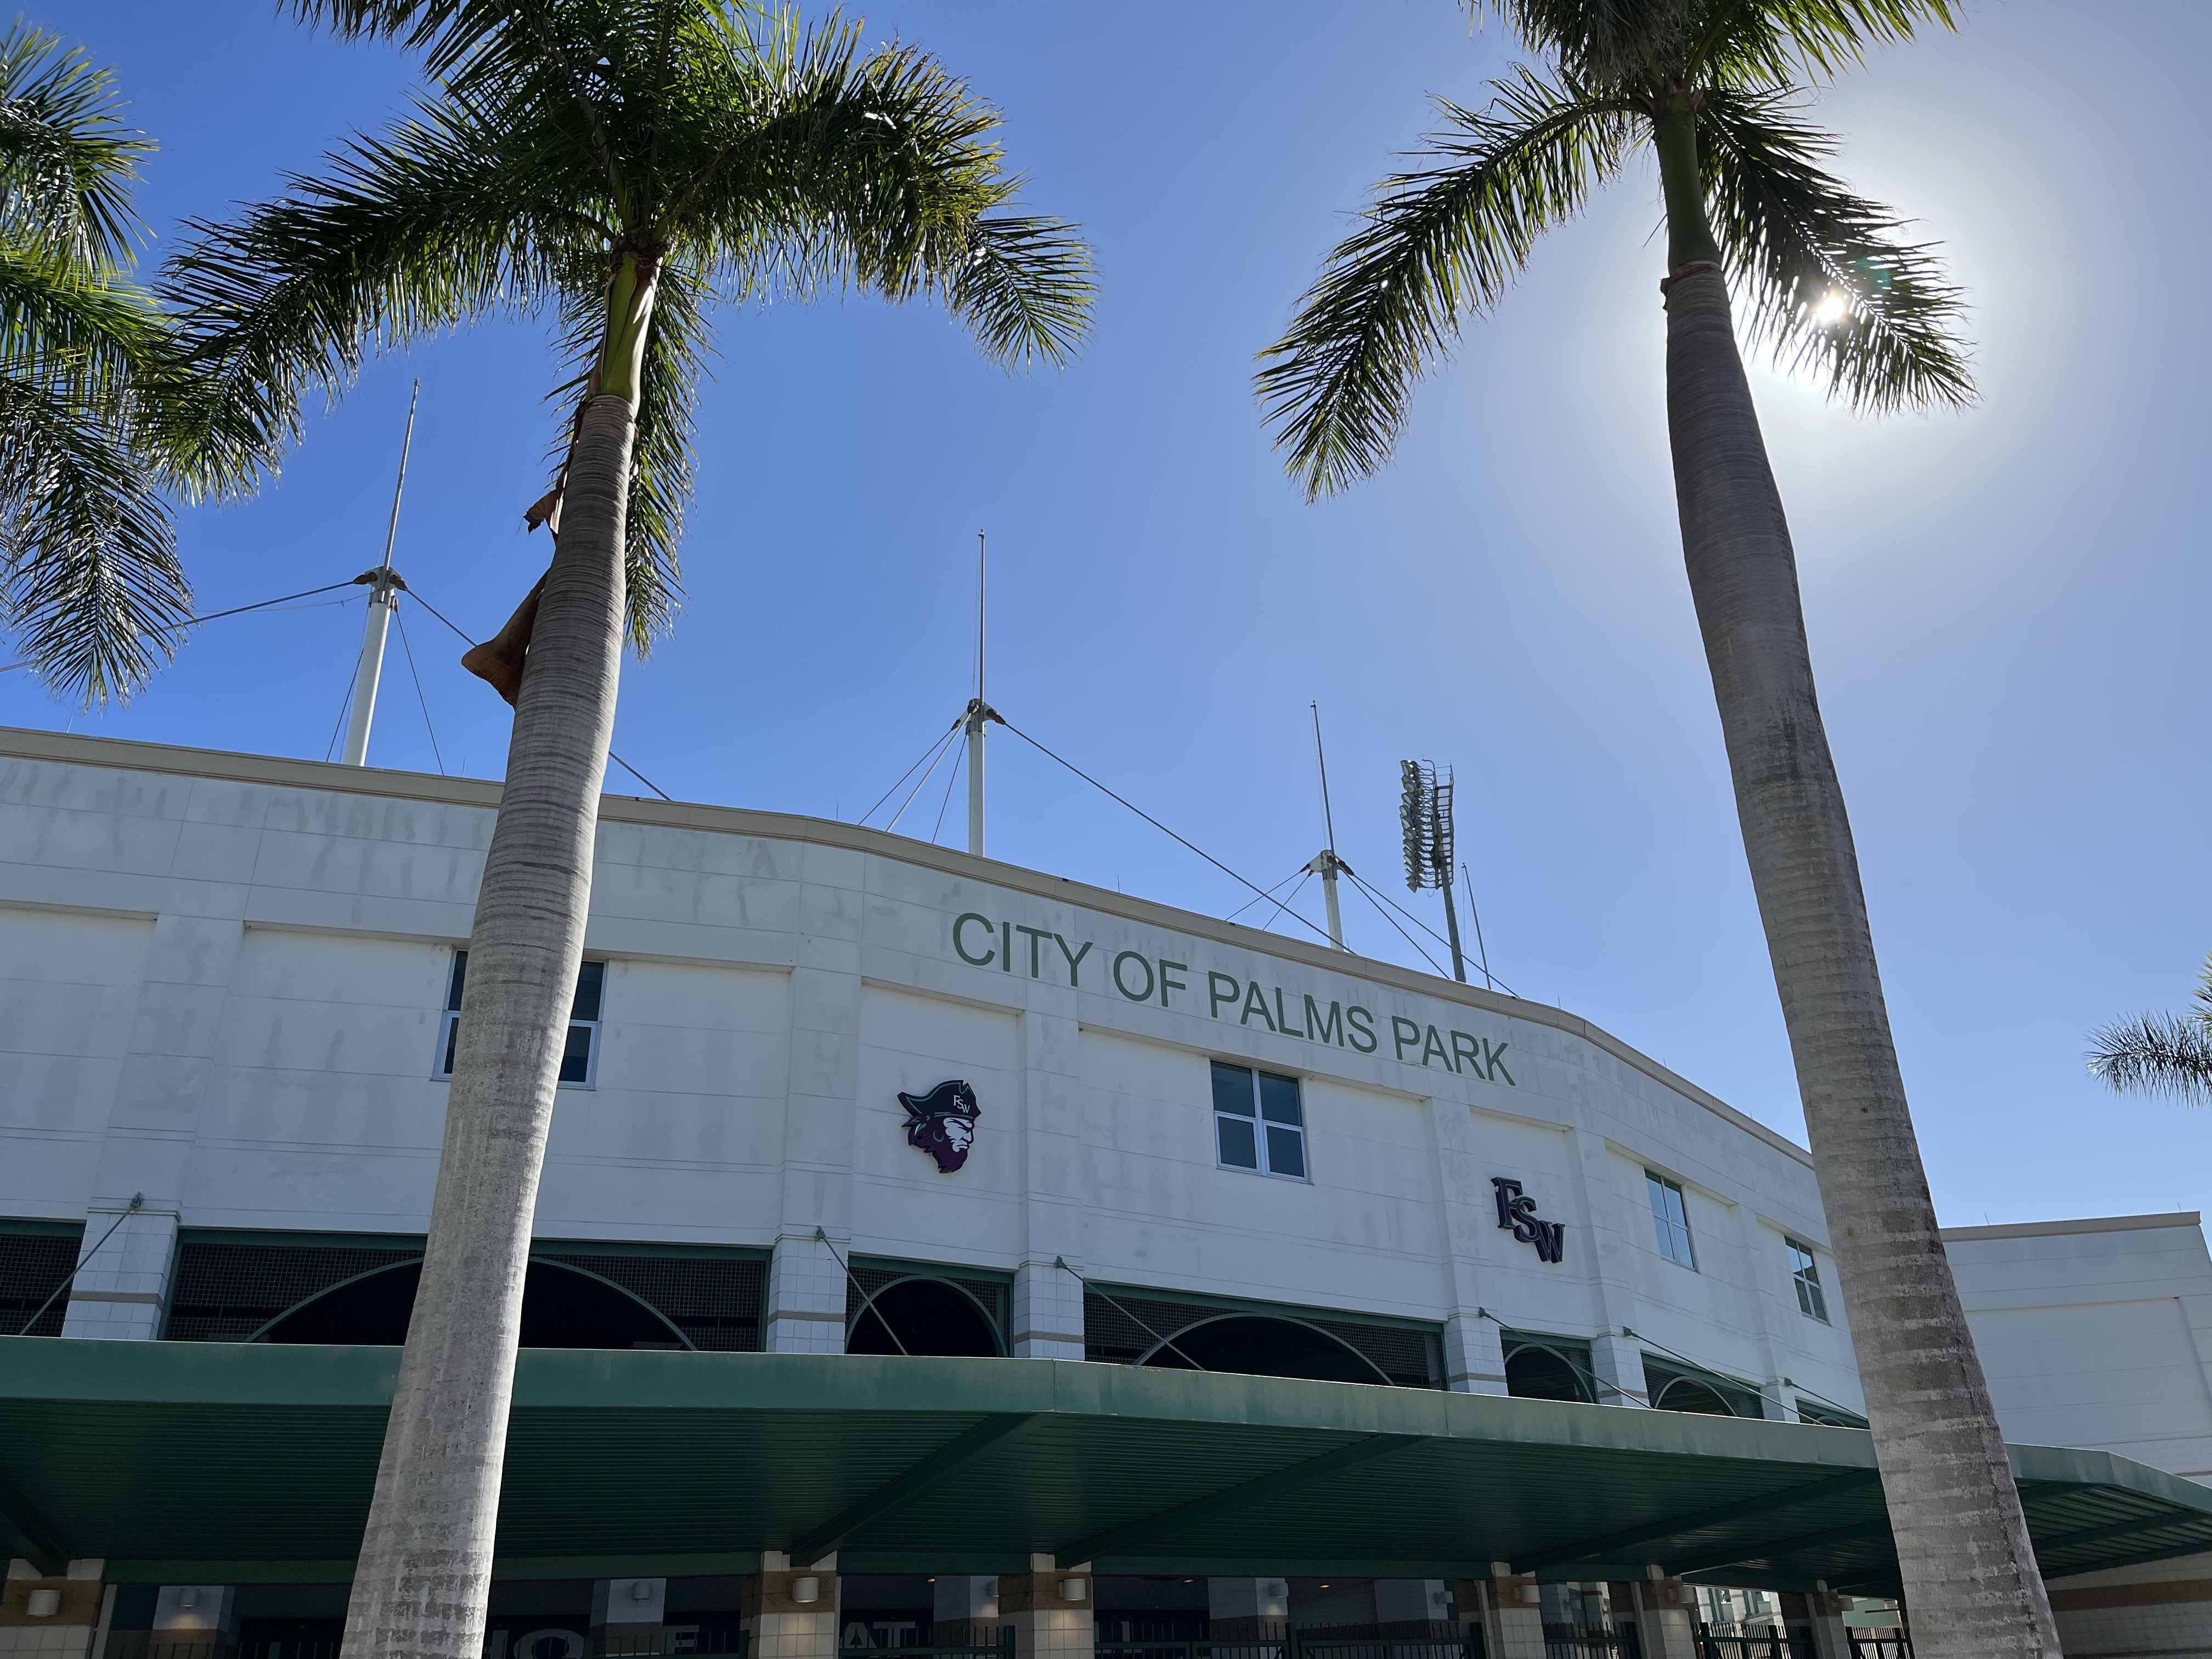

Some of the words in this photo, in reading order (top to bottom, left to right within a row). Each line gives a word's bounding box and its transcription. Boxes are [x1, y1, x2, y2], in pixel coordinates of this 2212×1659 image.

[953, 912, 1093, 987] CITY
[1113, 950, 1188, 1007] OF
[1208, 970, 1378, 1053] PALMS
[1391, 1015, 1516, 1086] PARK
[952, 1094, 970, 1114] FSW
[1490, 1176, 1566, 1264] FSW
